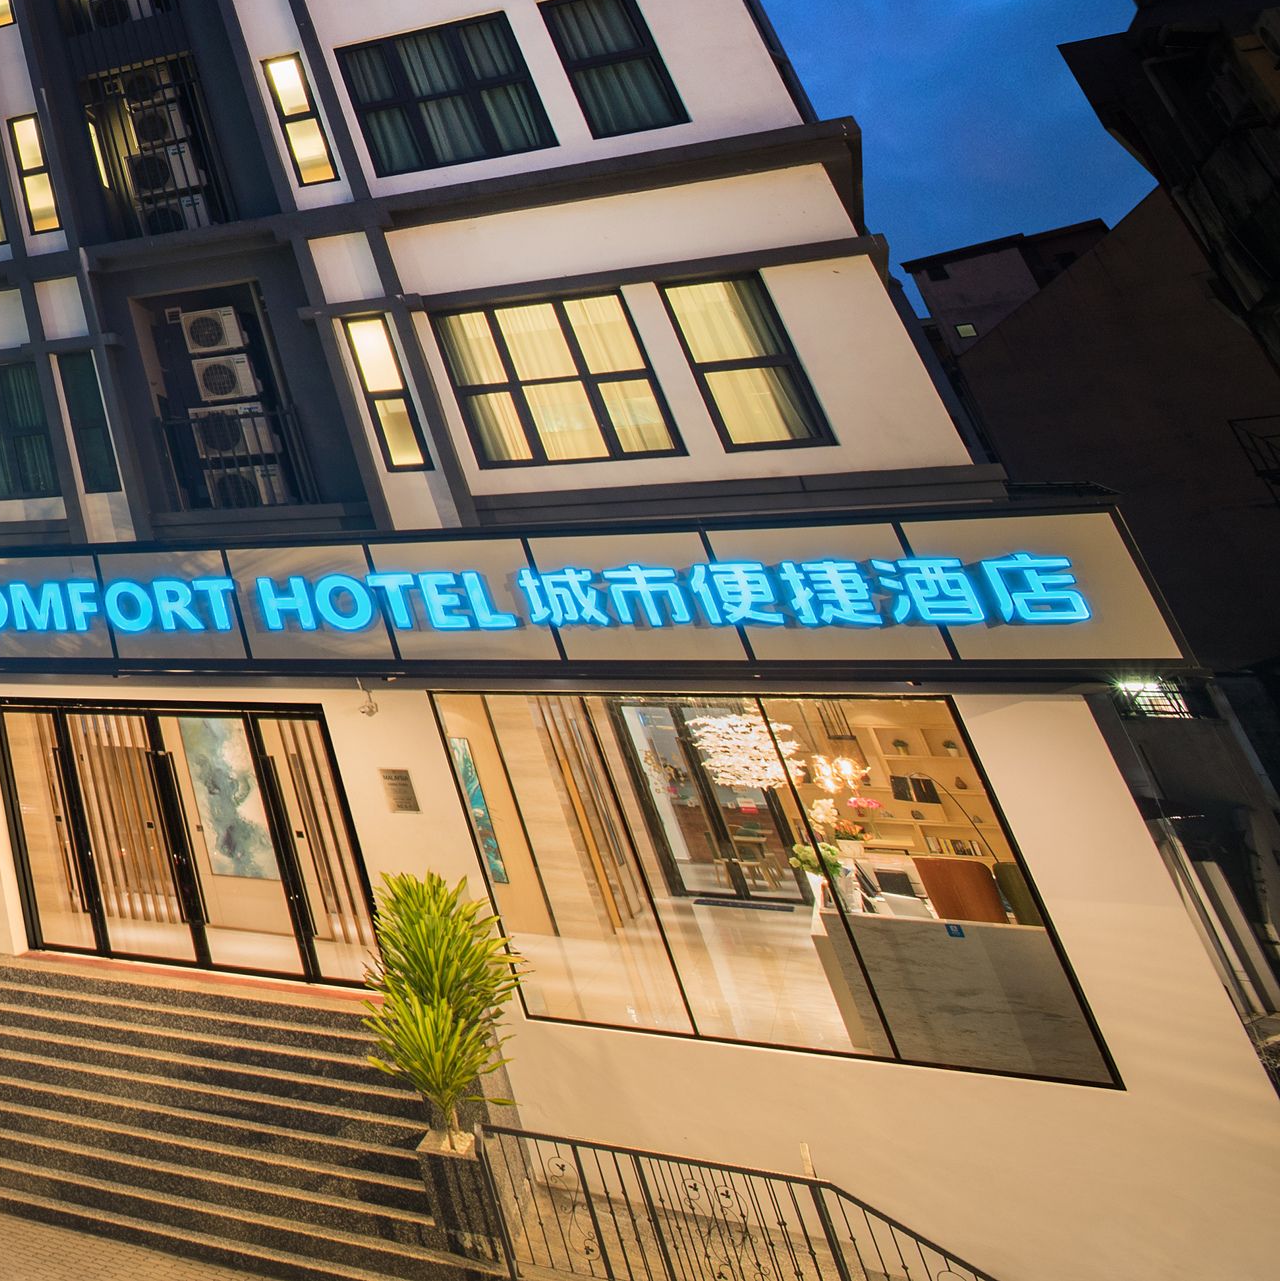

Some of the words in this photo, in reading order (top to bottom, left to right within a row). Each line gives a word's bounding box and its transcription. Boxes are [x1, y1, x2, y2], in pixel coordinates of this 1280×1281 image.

[255, 569, 518, 631] HOTEL
[517, 552, 1092, 628] 城市便捷酒店
